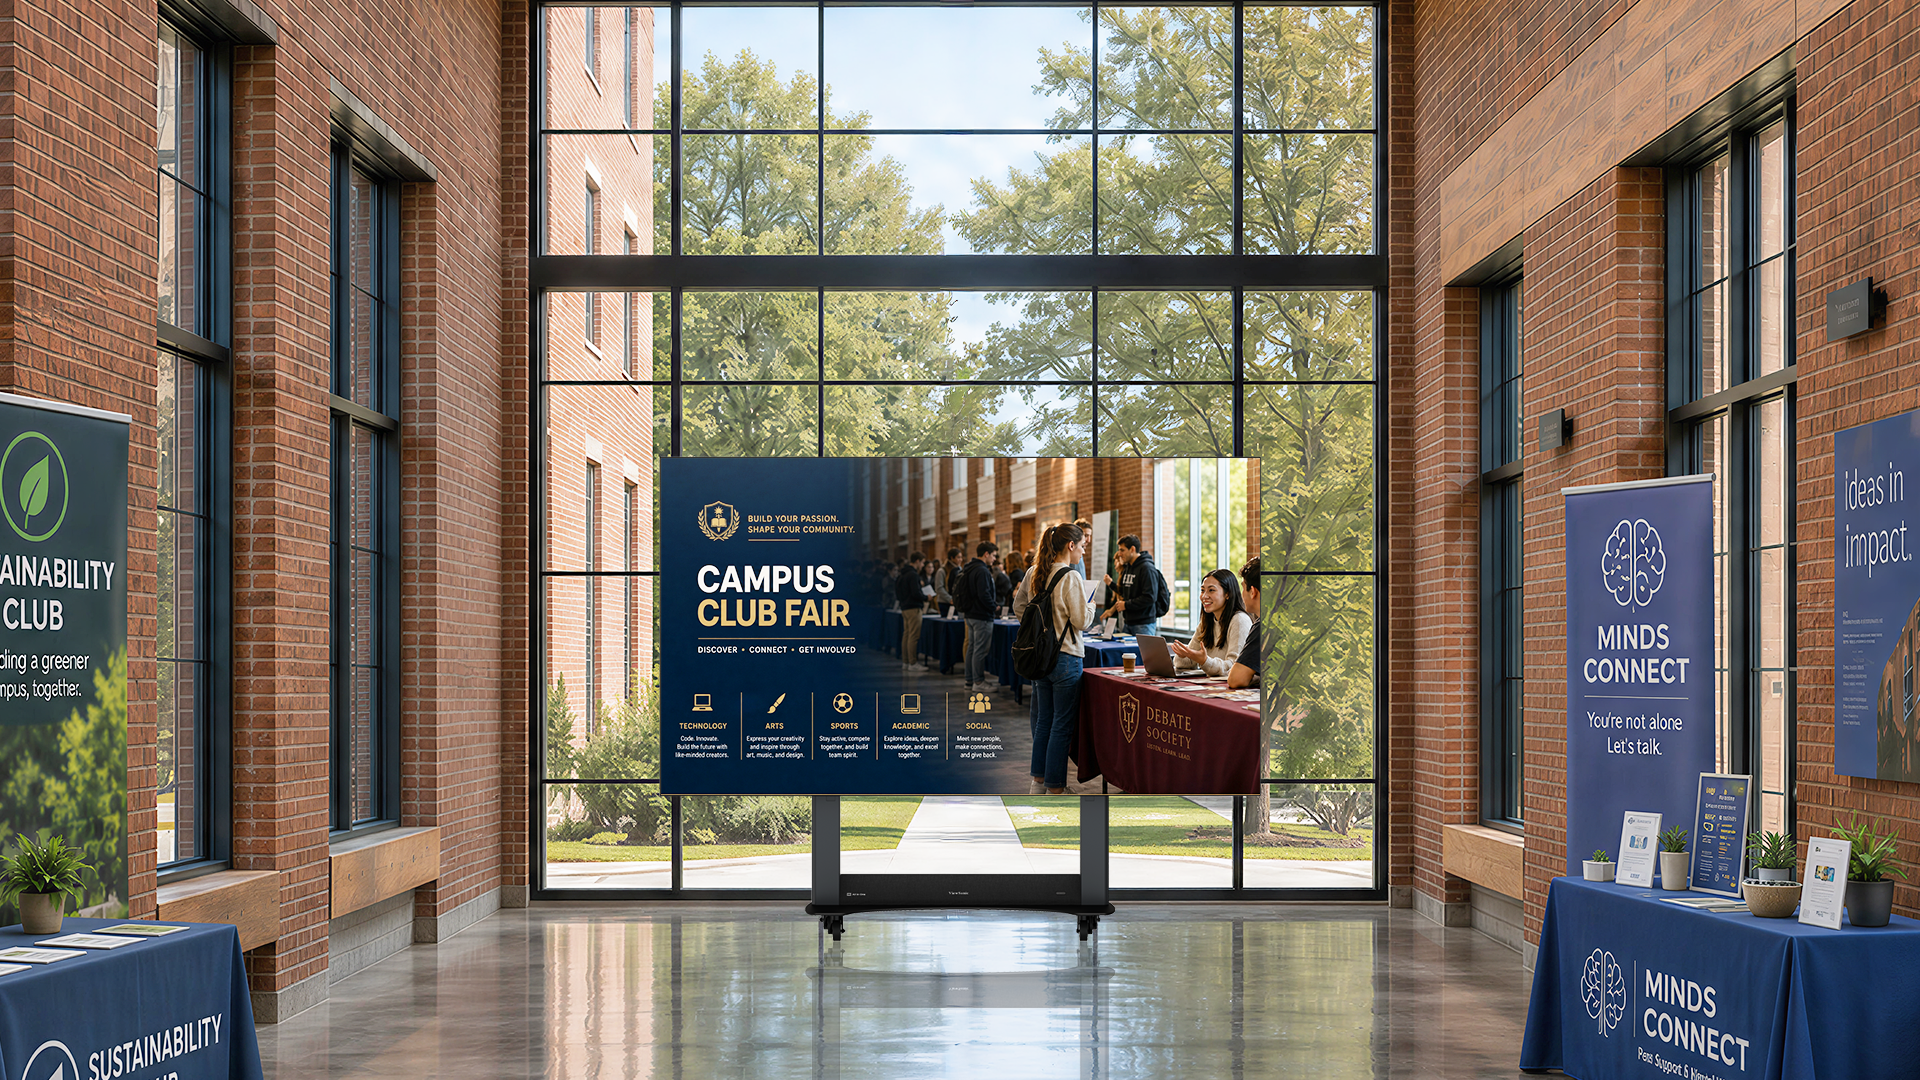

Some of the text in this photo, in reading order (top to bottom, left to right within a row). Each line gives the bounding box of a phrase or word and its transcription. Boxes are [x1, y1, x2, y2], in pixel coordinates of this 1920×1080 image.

[1889, 461, 1904, 503] in
[748, 515, 839, 523] BUILD YOUR PASSION.
[748, 526, 856, 534] SHAPE YOUR COMMUNITY.
[0, 554, 115, 590] AINABILITY
[697, 564, 835, 594] CAMPUS
[3, 597, 64, 631] CLUB
[697, 598, 850, 627] CLUB FAIR
[1597, 623, 1670, 650] MINDS
[697, 646, 857, 654] DISCOVER CONNECT GET INVOLVED
[31, 654, 39, 670] a
[41, 653, 89, 675] greener
[1583, 658, 1690, 684] CONNECT
[32, 679, 82, 702] together.
[1146, 706, 1192, 732] DEBATE
[1587, 711, 1683, 731] You're not alone
[679, 722, 728, 730] TECHNOLOGY
[765, 722, 784, 730] ARTS
[830, 722, 859, 730] SPORTS
[892, 722, 930, 730] ACADEMIC
[965, 722, 993, 730] SOCIAL
[746, 735, 767, 743] Express
[781, 735, 805, 743] creativity
[819, 735, 871, 743] Stay active, compete
[883, 735, 939, 743] Explore ideas, deepen
[982, 735, 1002, 743] people,
[1146, 725, 1192, 749] SOCIETY
[761, 743, 779, 751] inspire
[779, 743, 800, 751] through
[820, 743, 844, 751] together,
[883, 743, 914, 751] knowledge,
[970, 743, 1004, 751] connections,
[1607, 736, 1662, 755] Let's talk.
[1645, 968, 1717, 1018] MINDS
[1643, 1007, 1750, 1072] CONNECT
[88, 1013, 223, 1080] SUSTAINABILITY
